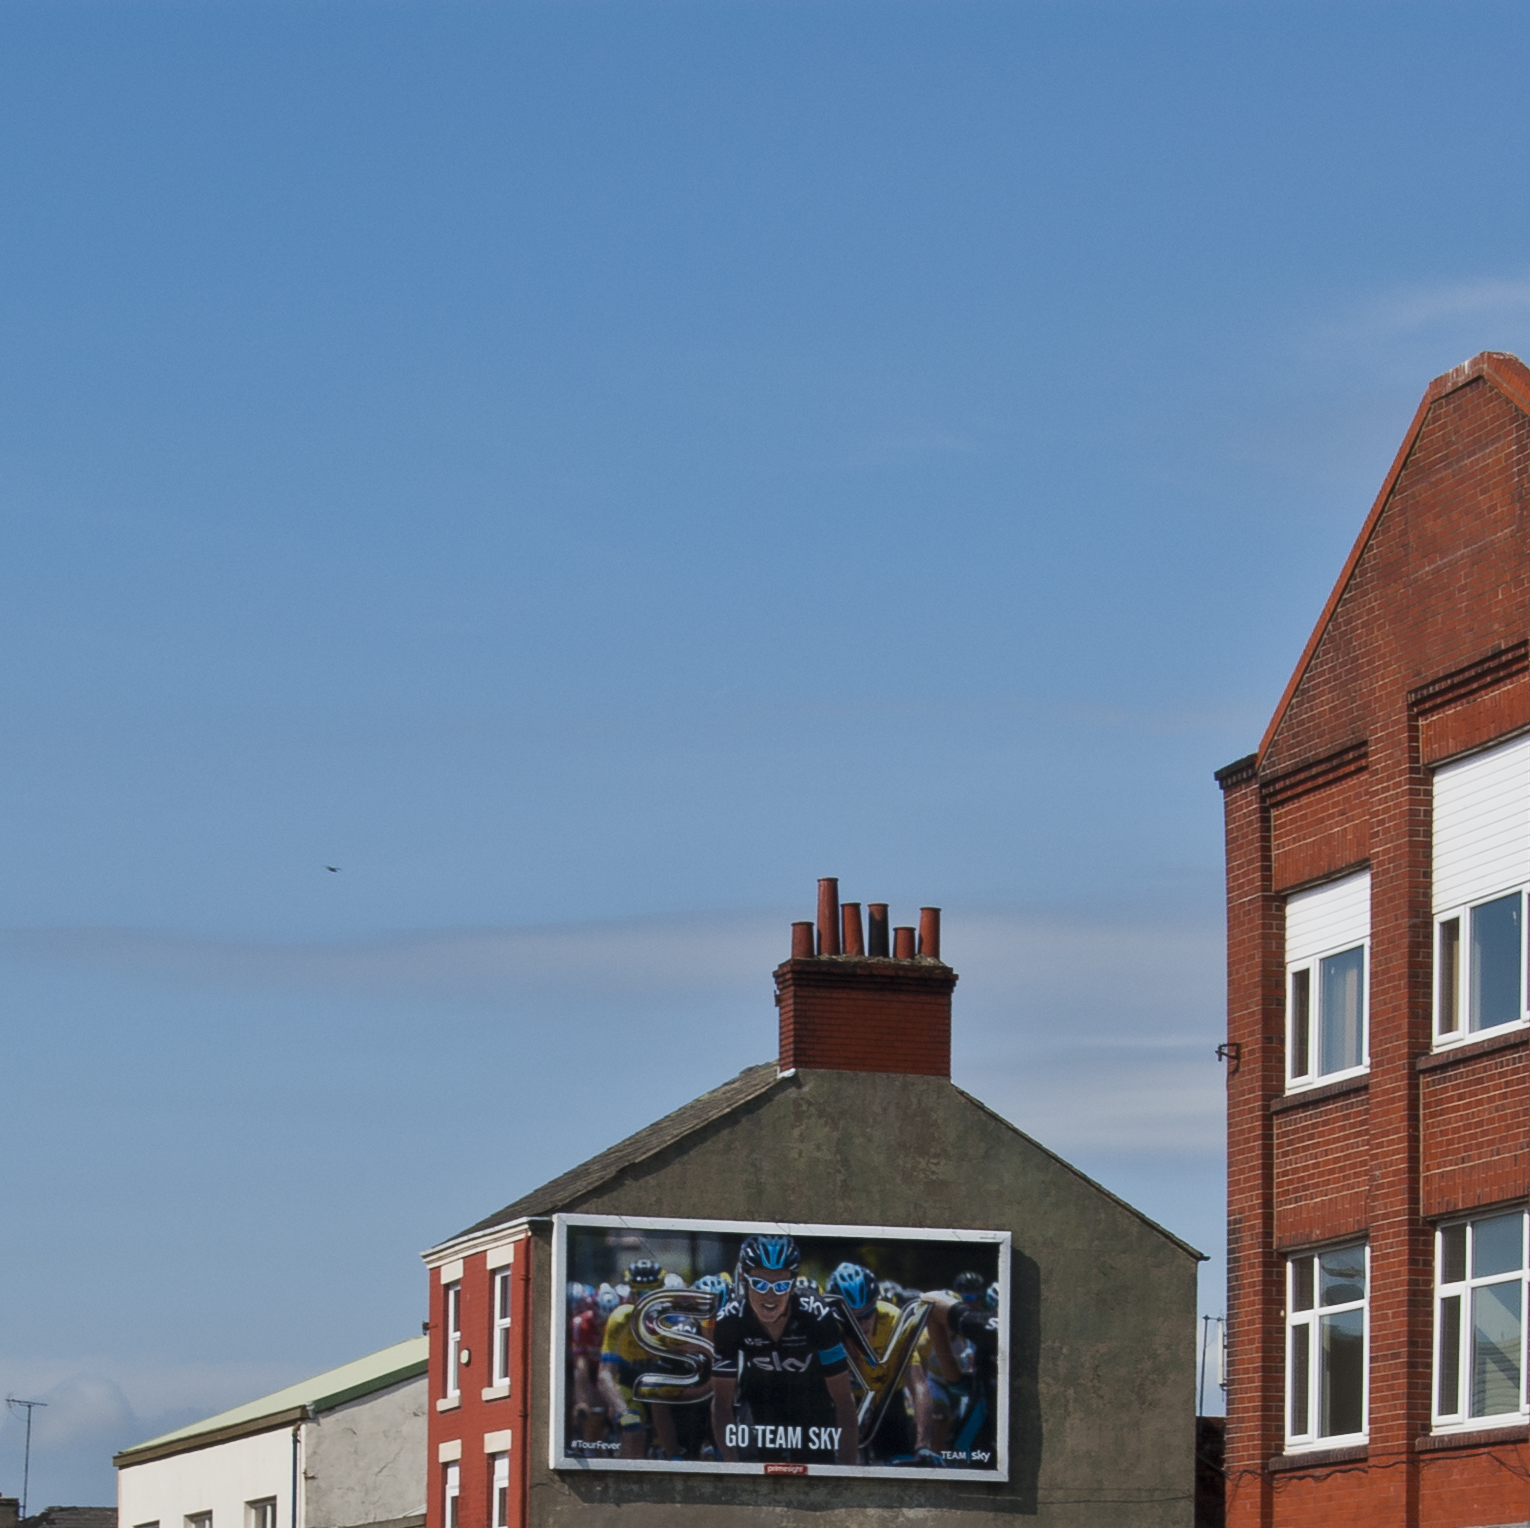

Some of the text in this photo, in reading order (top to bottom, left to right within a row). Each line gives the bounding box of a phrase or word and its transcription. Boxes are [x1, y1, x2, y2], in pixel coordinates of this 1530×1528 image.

[799, 1297, 830, 1321] sky
[571, 1440, 621, 1450] #TourFever
[725, 1424, 842, 1450] GO TEAM SKY
[941, 1450, 991, 1463] TEAM sky
